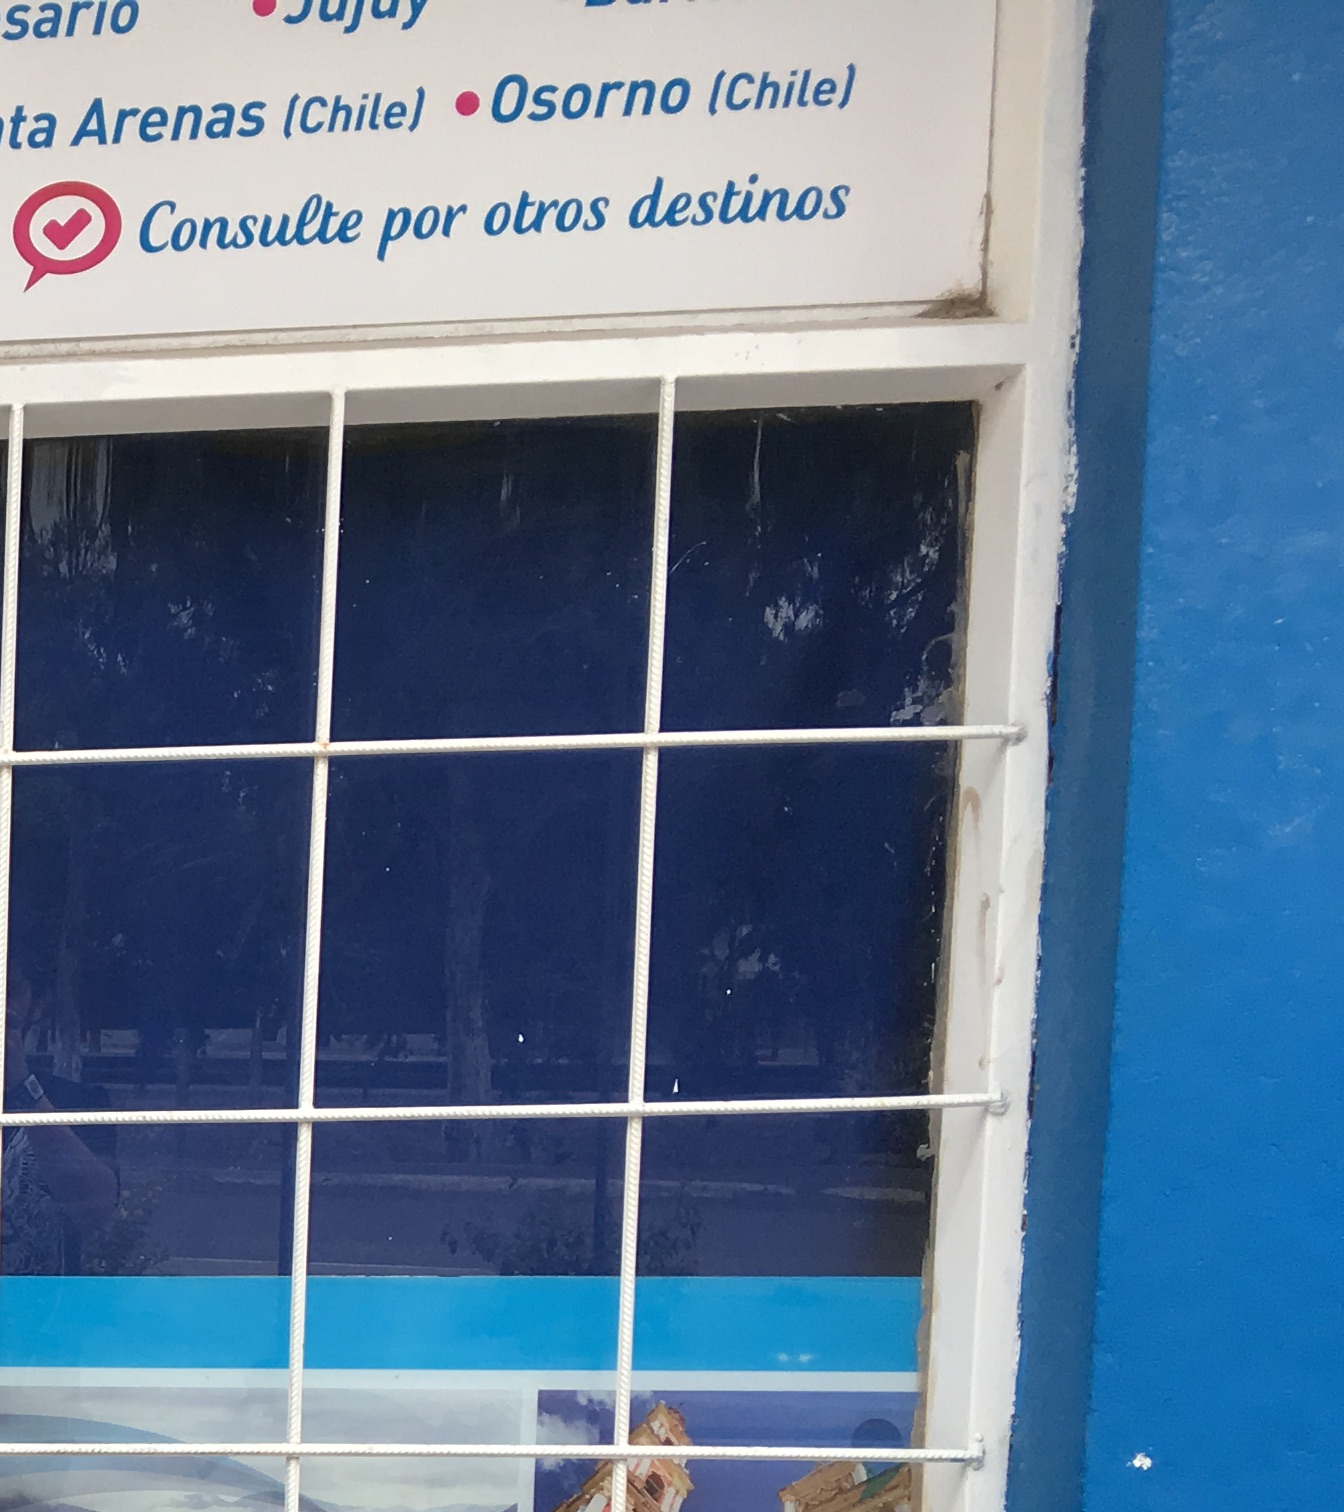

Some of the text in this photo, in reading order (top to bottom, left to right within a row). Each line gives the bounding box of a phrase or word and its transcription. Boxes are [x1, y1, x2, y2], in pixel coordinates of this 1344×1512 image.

[72, 99, 264, 145] Arenas
[284, 88, 424, 137] (Chile)
[492, 65, 854, 123] Osorno (Chile)
[140, 175, 848, 260] Consulte por otros destinos
